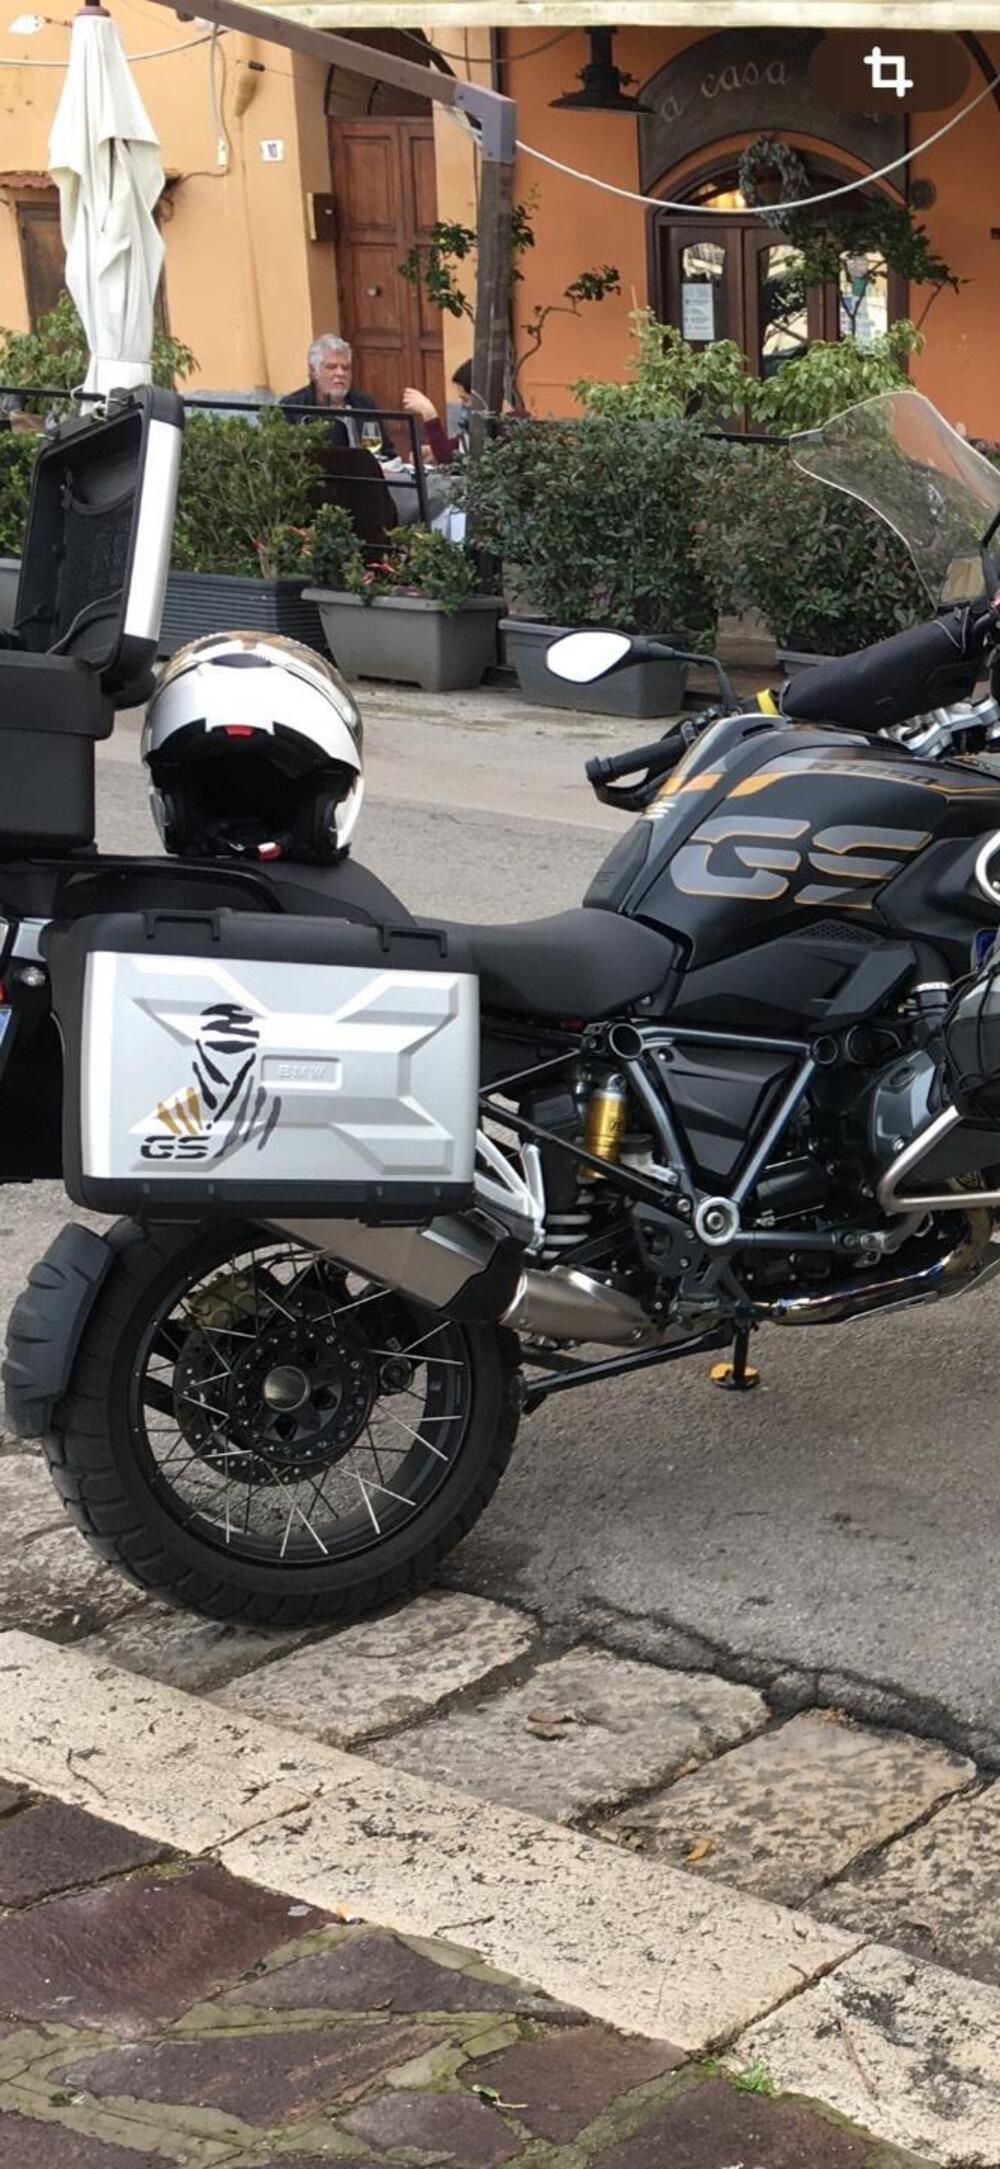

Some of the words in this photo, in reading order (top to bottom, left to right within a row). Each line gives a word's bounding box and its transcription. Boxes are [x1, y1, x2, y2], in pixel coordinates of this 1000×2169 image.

[700, 60, 792, 98] casa
[669, 815, 933, 910] GS
[278, 1063, 326, 1079] BMW
[140, 1135, 210, 1159] GS
